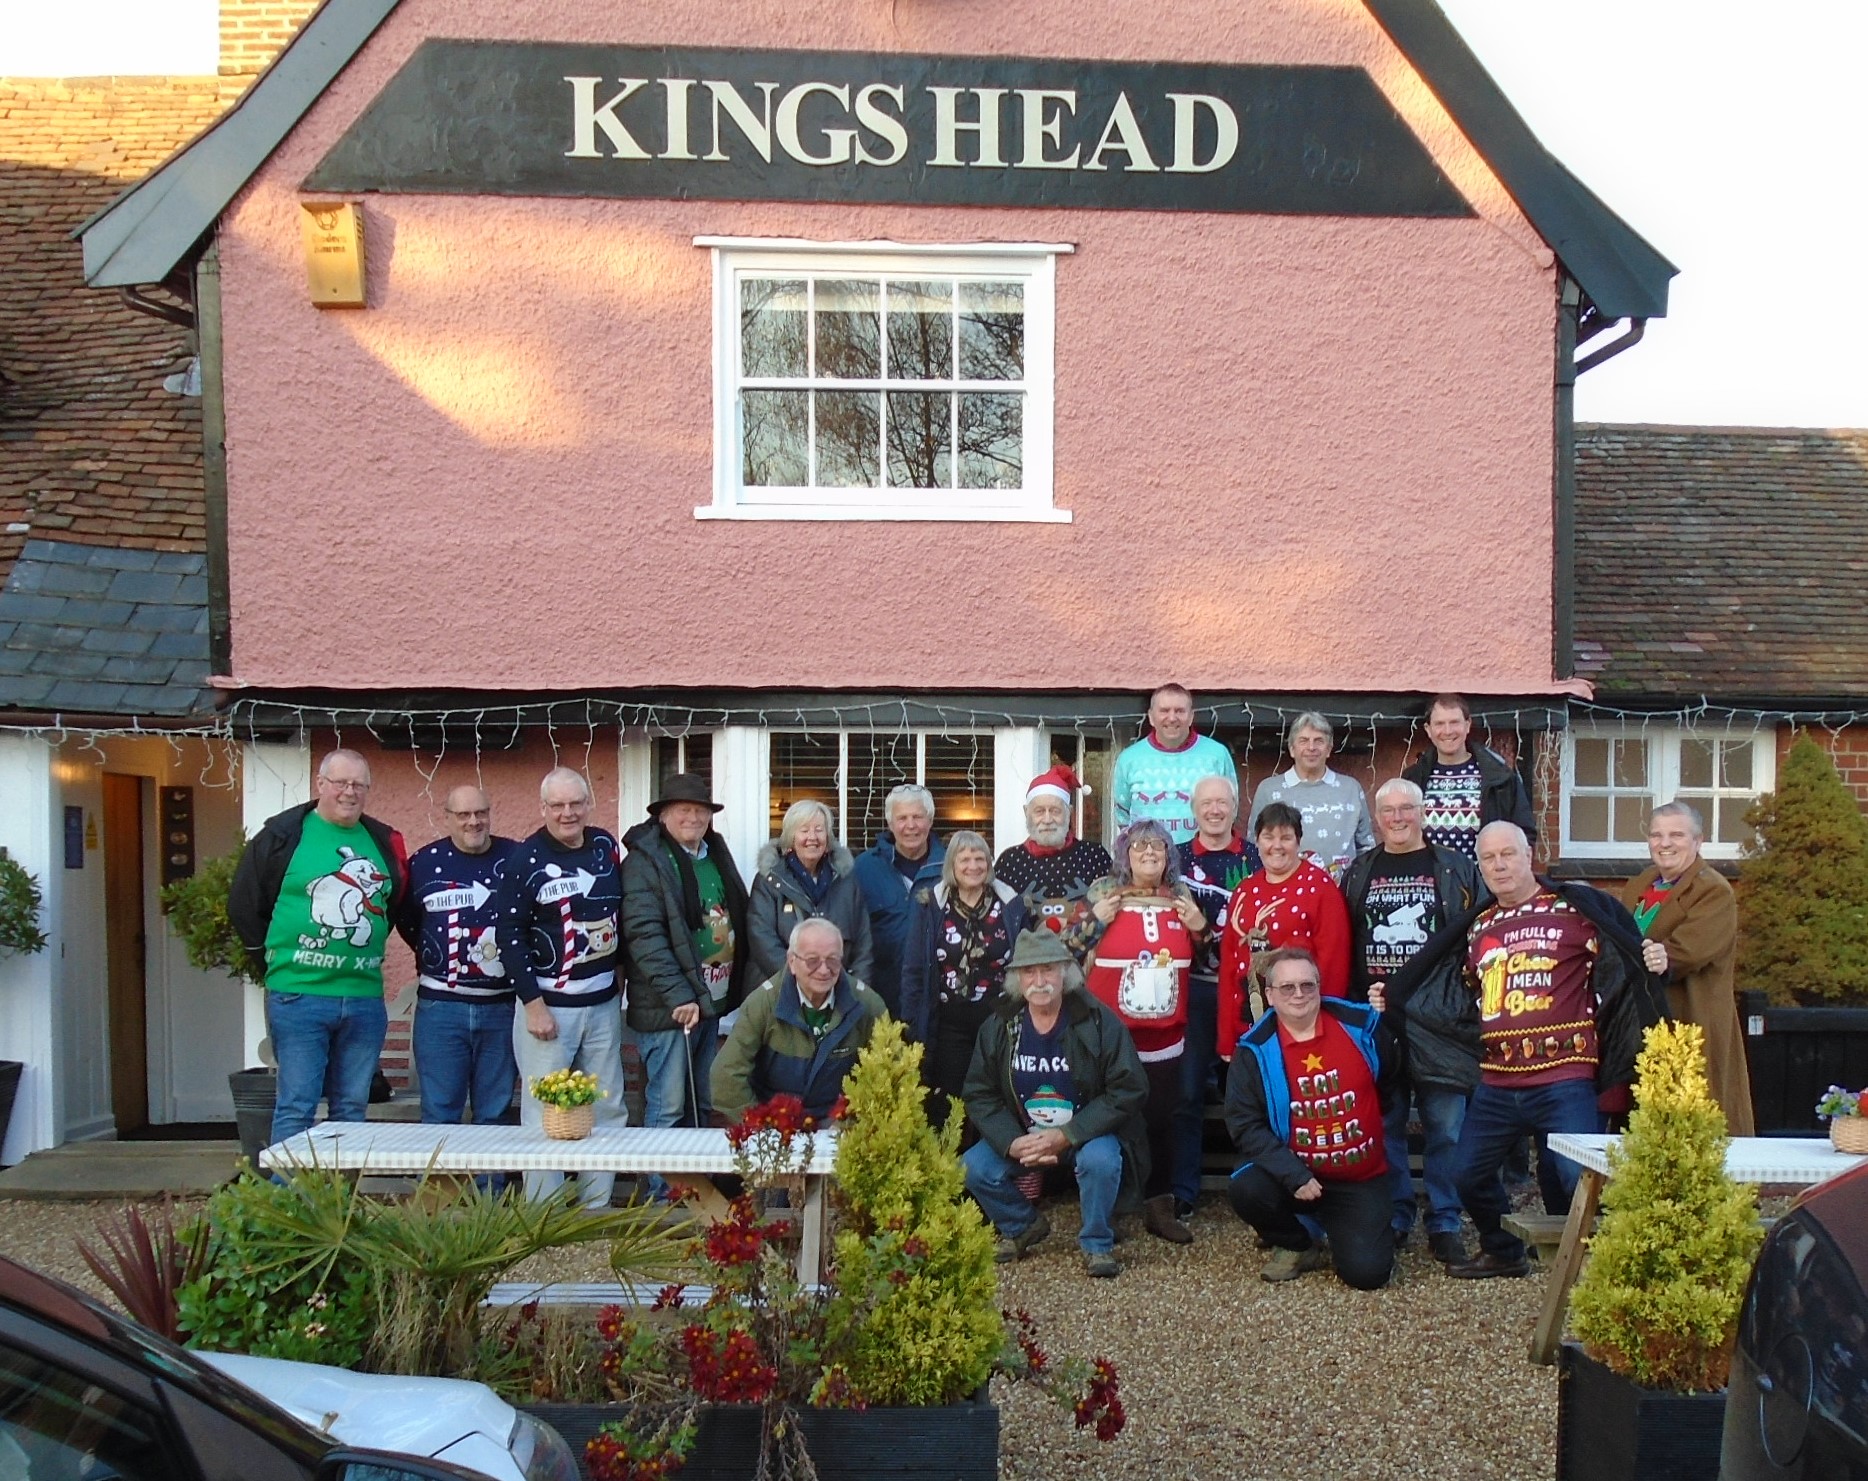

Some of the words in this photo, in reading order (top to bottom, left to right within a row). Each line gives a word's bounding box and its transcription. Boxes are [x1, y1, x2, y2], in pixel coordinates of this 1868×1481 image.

[563, 76, 908, 168] KINGS
[926, 86, 1239, 173] HEAD
[545, 885, 560, 898] THE
[560, 881, 579, 894] PUB
[1366, 894, 1380, 904] OH
[1381, 893, 1411, 903] WHAT
[1412, 893, 1436, 903] FUN
[436, 894, 452, 907] THE
[454, 893, 475, 906] PUB
[1504, 930, 1519, 944] I'M
[1520, 926, 1546, 940] FULL
[1547, 927, 1563, 940] OF
[292, 949, 347, 969] MERRY
[1365, 945, 1374, 955] IT
[1376, 945, 1387, 955] IS
[1390, 945, 1404, 955] TO
[1507, 951, 1559, 974] Cheer
[1506, 976, 1511, 990] I
[1512, 971, 1552, 989] MEAN
[1504, 990, 1554, 1017] Beer
[1038, 1057, 1050, 1072] A
[1297, 1068, 1339, 1097] EAT
[1290, 1090, 1357, 1119] SLEEP
[1295, 1118, 1364, 1150] BEER
